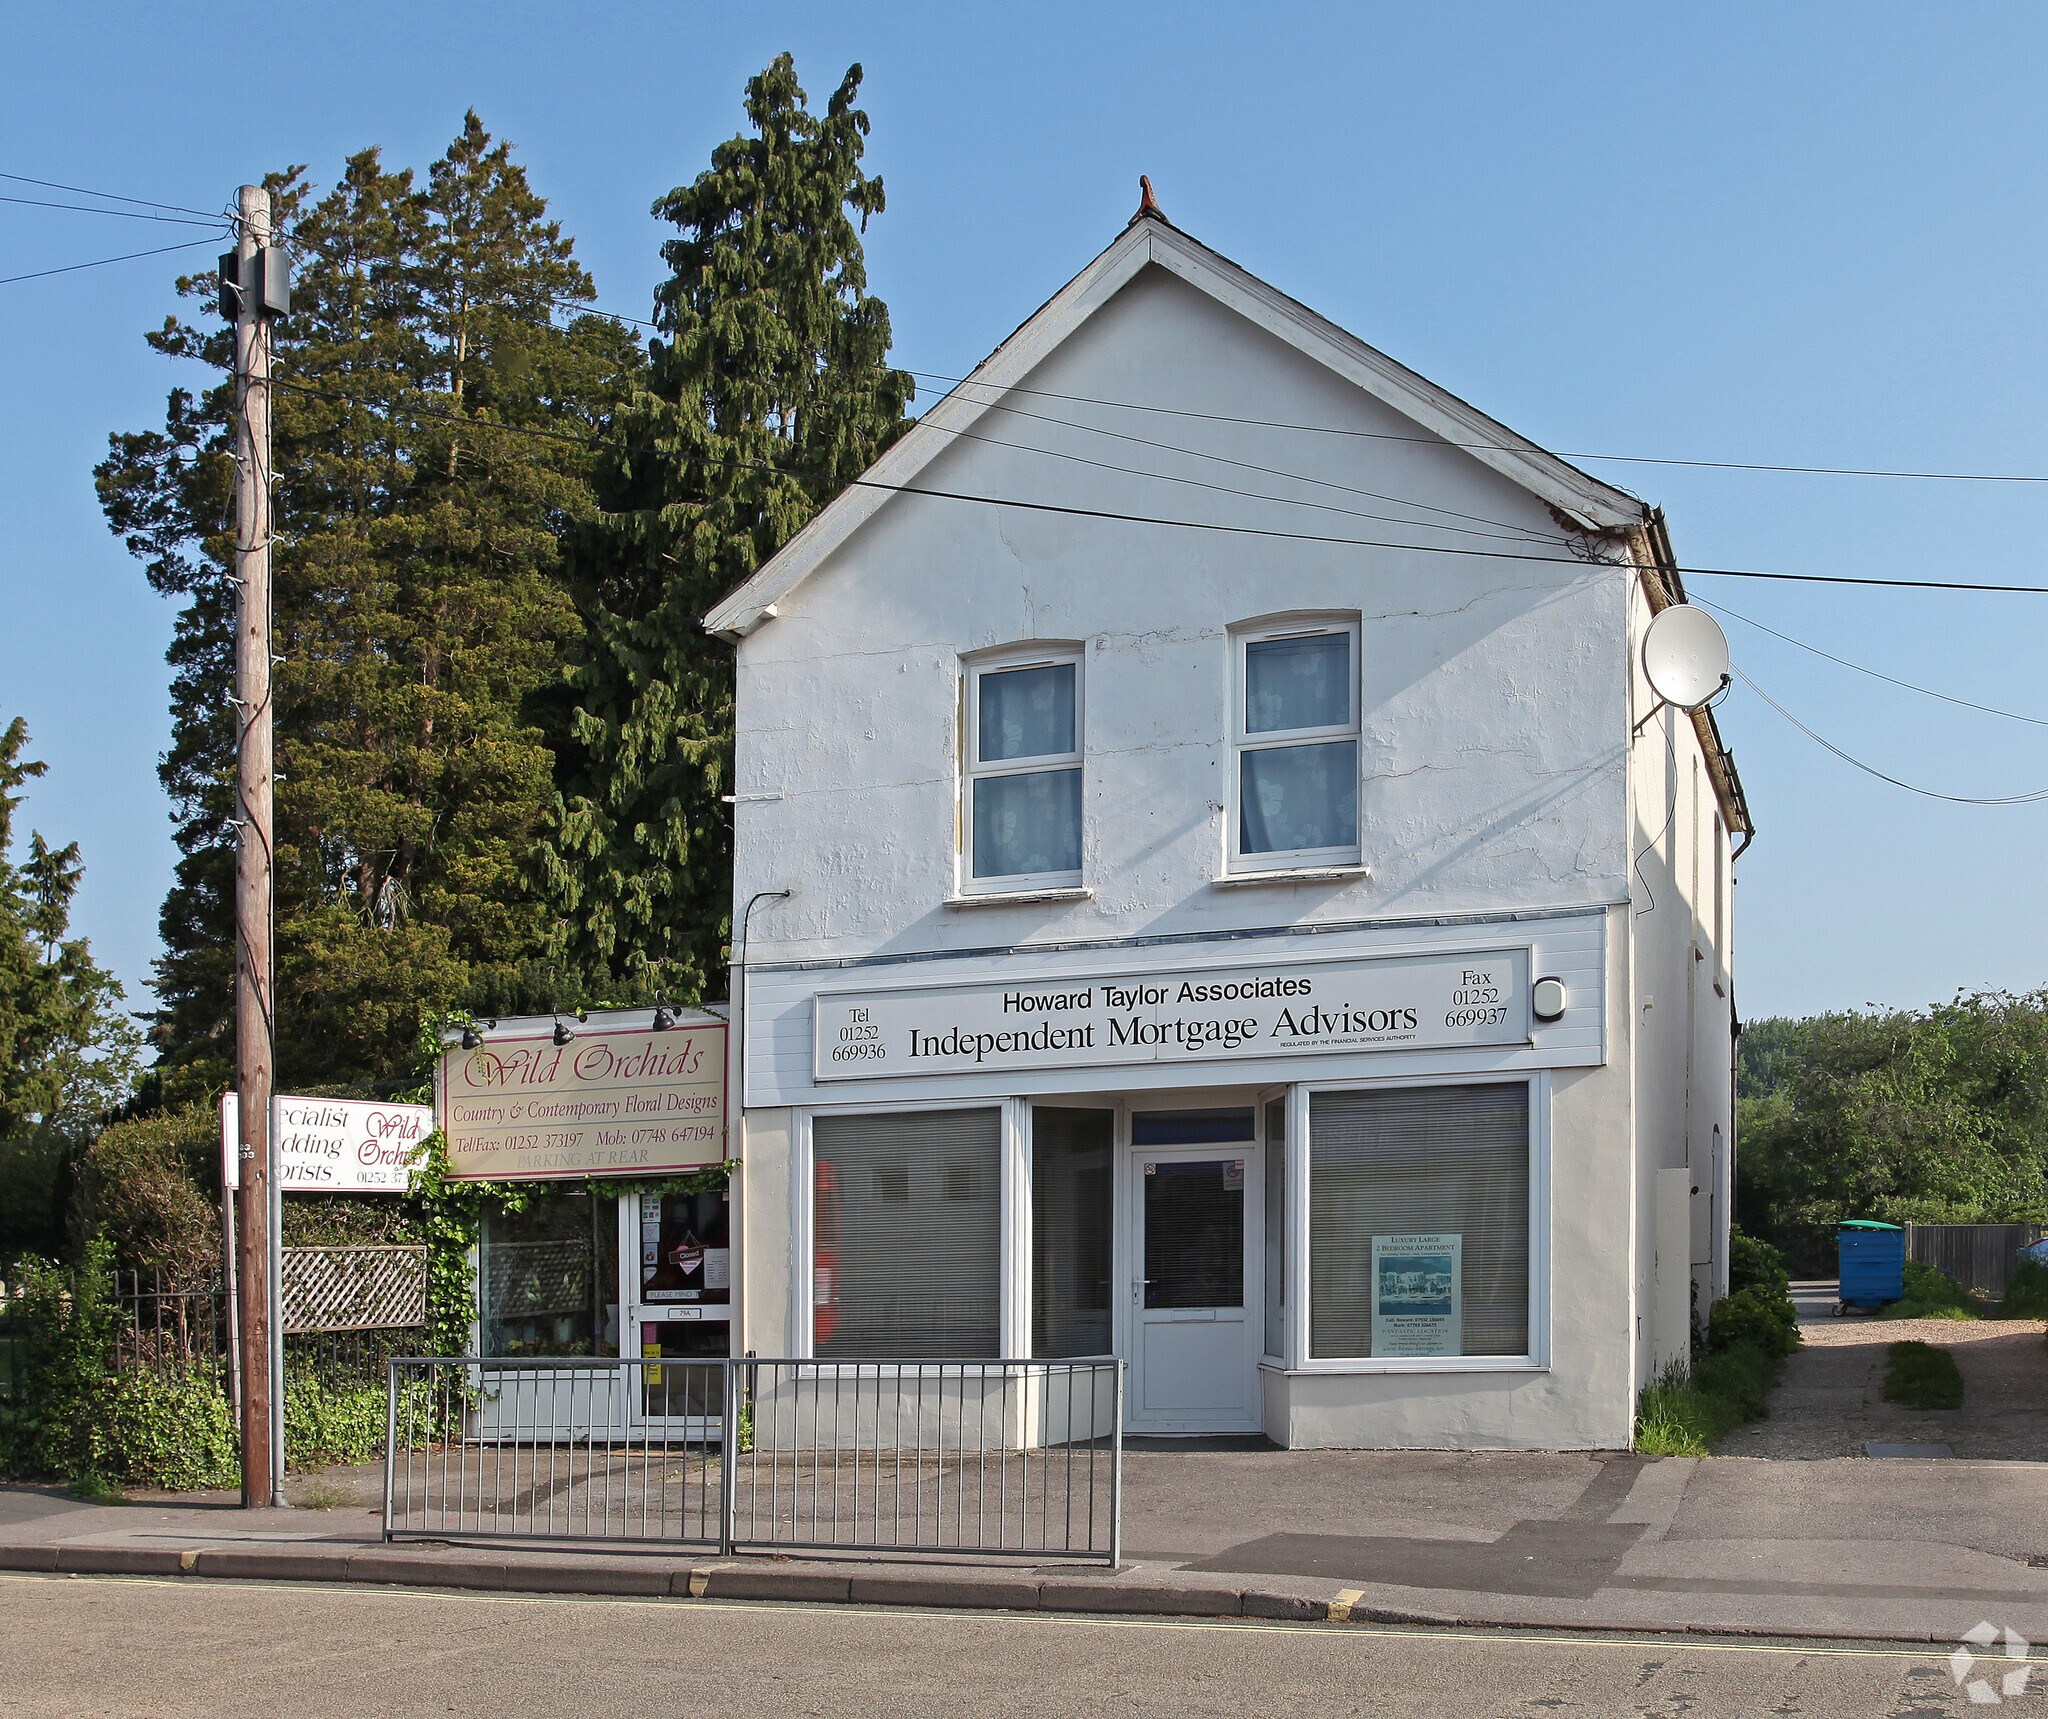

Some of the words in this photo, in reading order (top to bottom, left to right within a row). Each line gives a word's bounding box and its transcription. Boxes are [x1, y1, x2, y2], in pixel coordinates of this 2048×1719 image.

[1461, 970, 1491, 986] Fax
[1003, 988, 1092, 1013] Howard
[1101, 984, 1169, 1012] Taylor
[1176, 977, 1312, 1004] Associates
[1453, 988, 1499, 1006] 01252
[849, 1008, 870, 1023] Tel
[1445, 1008, 1507, 1027] 669937
[839, 1025, 879, 1042] 01252
[908, 1022, 1095, 1063] Independent
[1107, 1015, 1258, 1051] Mortgage
[1270, 1003, 1418, 1038] Advisors
[832, 1044, 886, 1062] 669936
[464, 1047, 563, 1088] Wild
[573, 1038, 705, 1081] Orchids
[453, 1104, 505, 1124] Country
[510, 1102, 524, 1119] &
[528, 1097, 620, 1120] Contemporary
[625, 1093, 662, 1113] Floral
[666, 1092, 717, 1115] Designs
[366, 1111, 420, 1140] Wild
[281, 1133, 344, 1159] dding
[456, 1137, 500, 1153] Tel/Fax:
[505, 1135, 538, 1151] 01252
[544, 1133, 584, 1149] 373197
[596, 1130, 627, 1147] Mob:
[631, 1129, 666, 1145] 07748
[671, 1126, 714, 1143] 647194
[517, 1151, 581, 1168] PARKING
[586, 1151, 604, 1165] AT
[608, 1150, 649, 1164] REAR
[356, 1171, 387, 1184] 01252
[680, 1250, 699, 1260] Closed
[1381, 1244, 1414, 1252] BEDROOM
[650, 1290, 673, 1298] PLEASE
[675, 1290, 692, 1298] MIND
